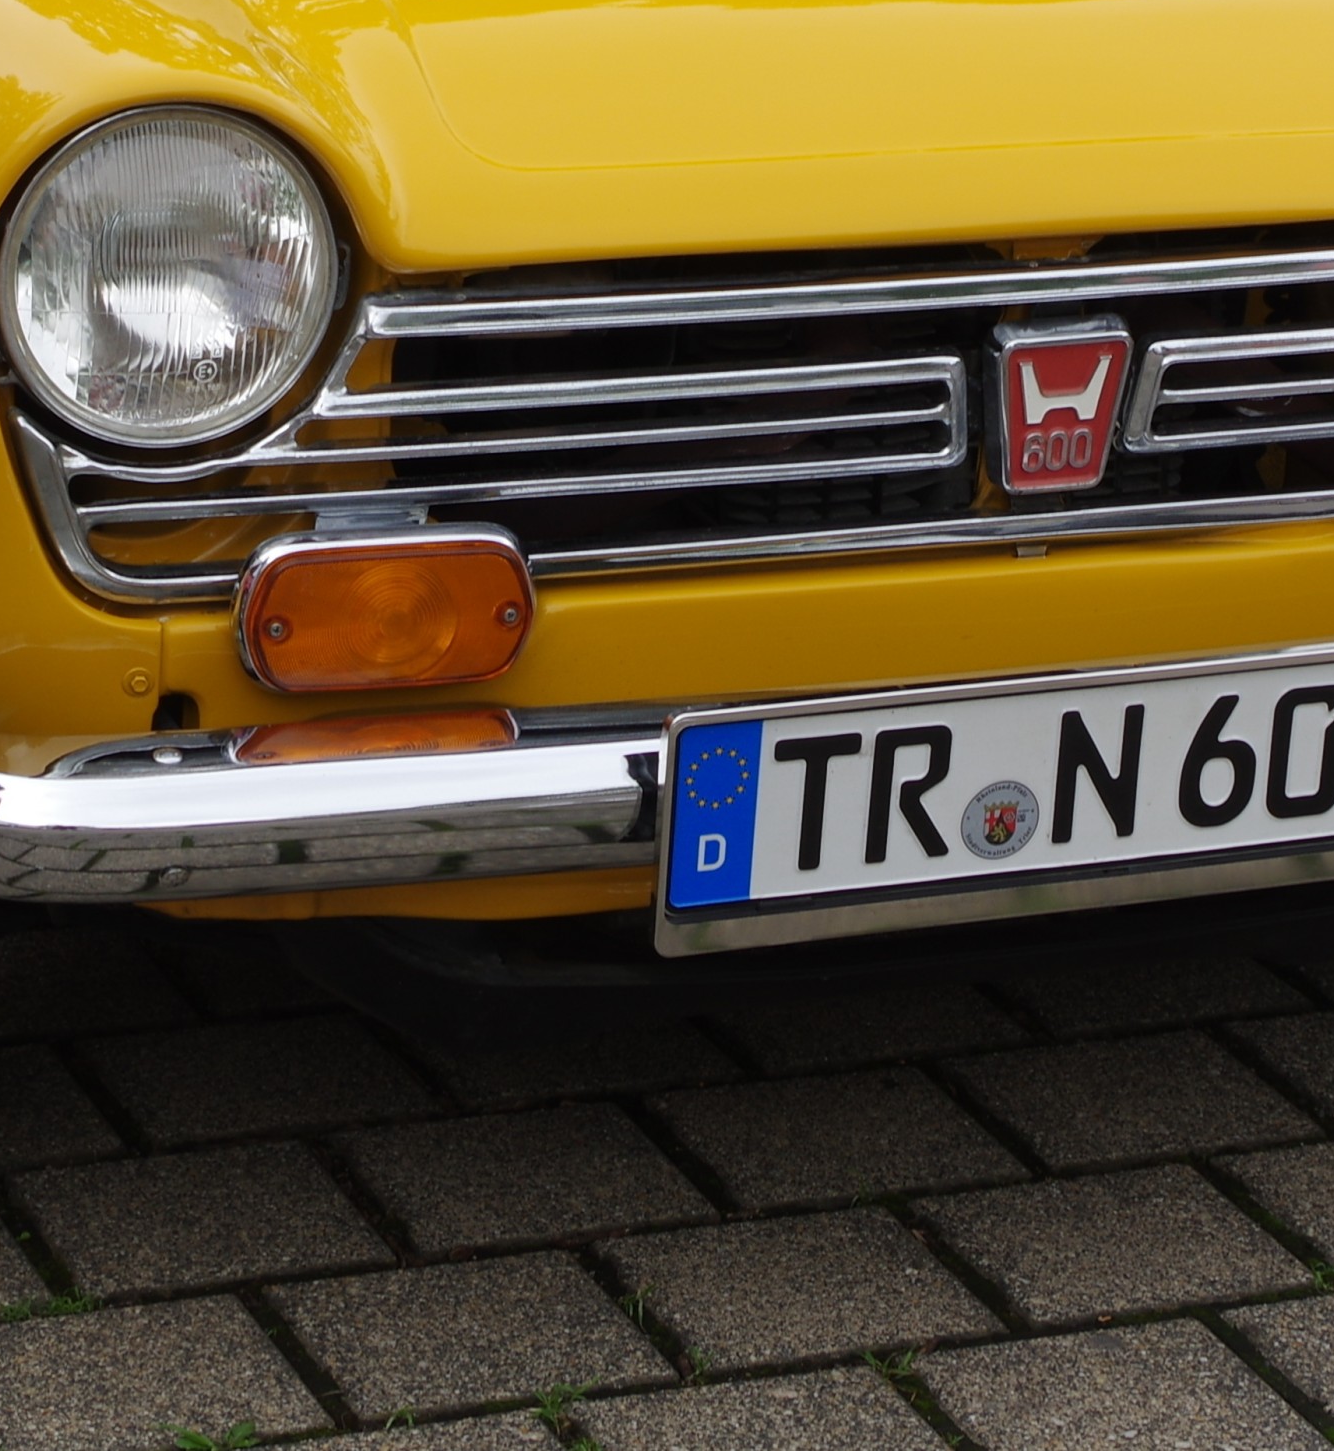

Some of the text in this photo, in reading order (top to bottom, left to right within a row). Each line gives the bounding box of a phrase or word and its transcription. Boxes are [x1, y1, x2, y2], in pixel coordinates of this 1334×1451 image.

[1021, 427, 1093, 474] 600
[774, 724, 953, 871] TR
[1051, 704, 1146, 845] N
[696, 833, 727, 873] D
